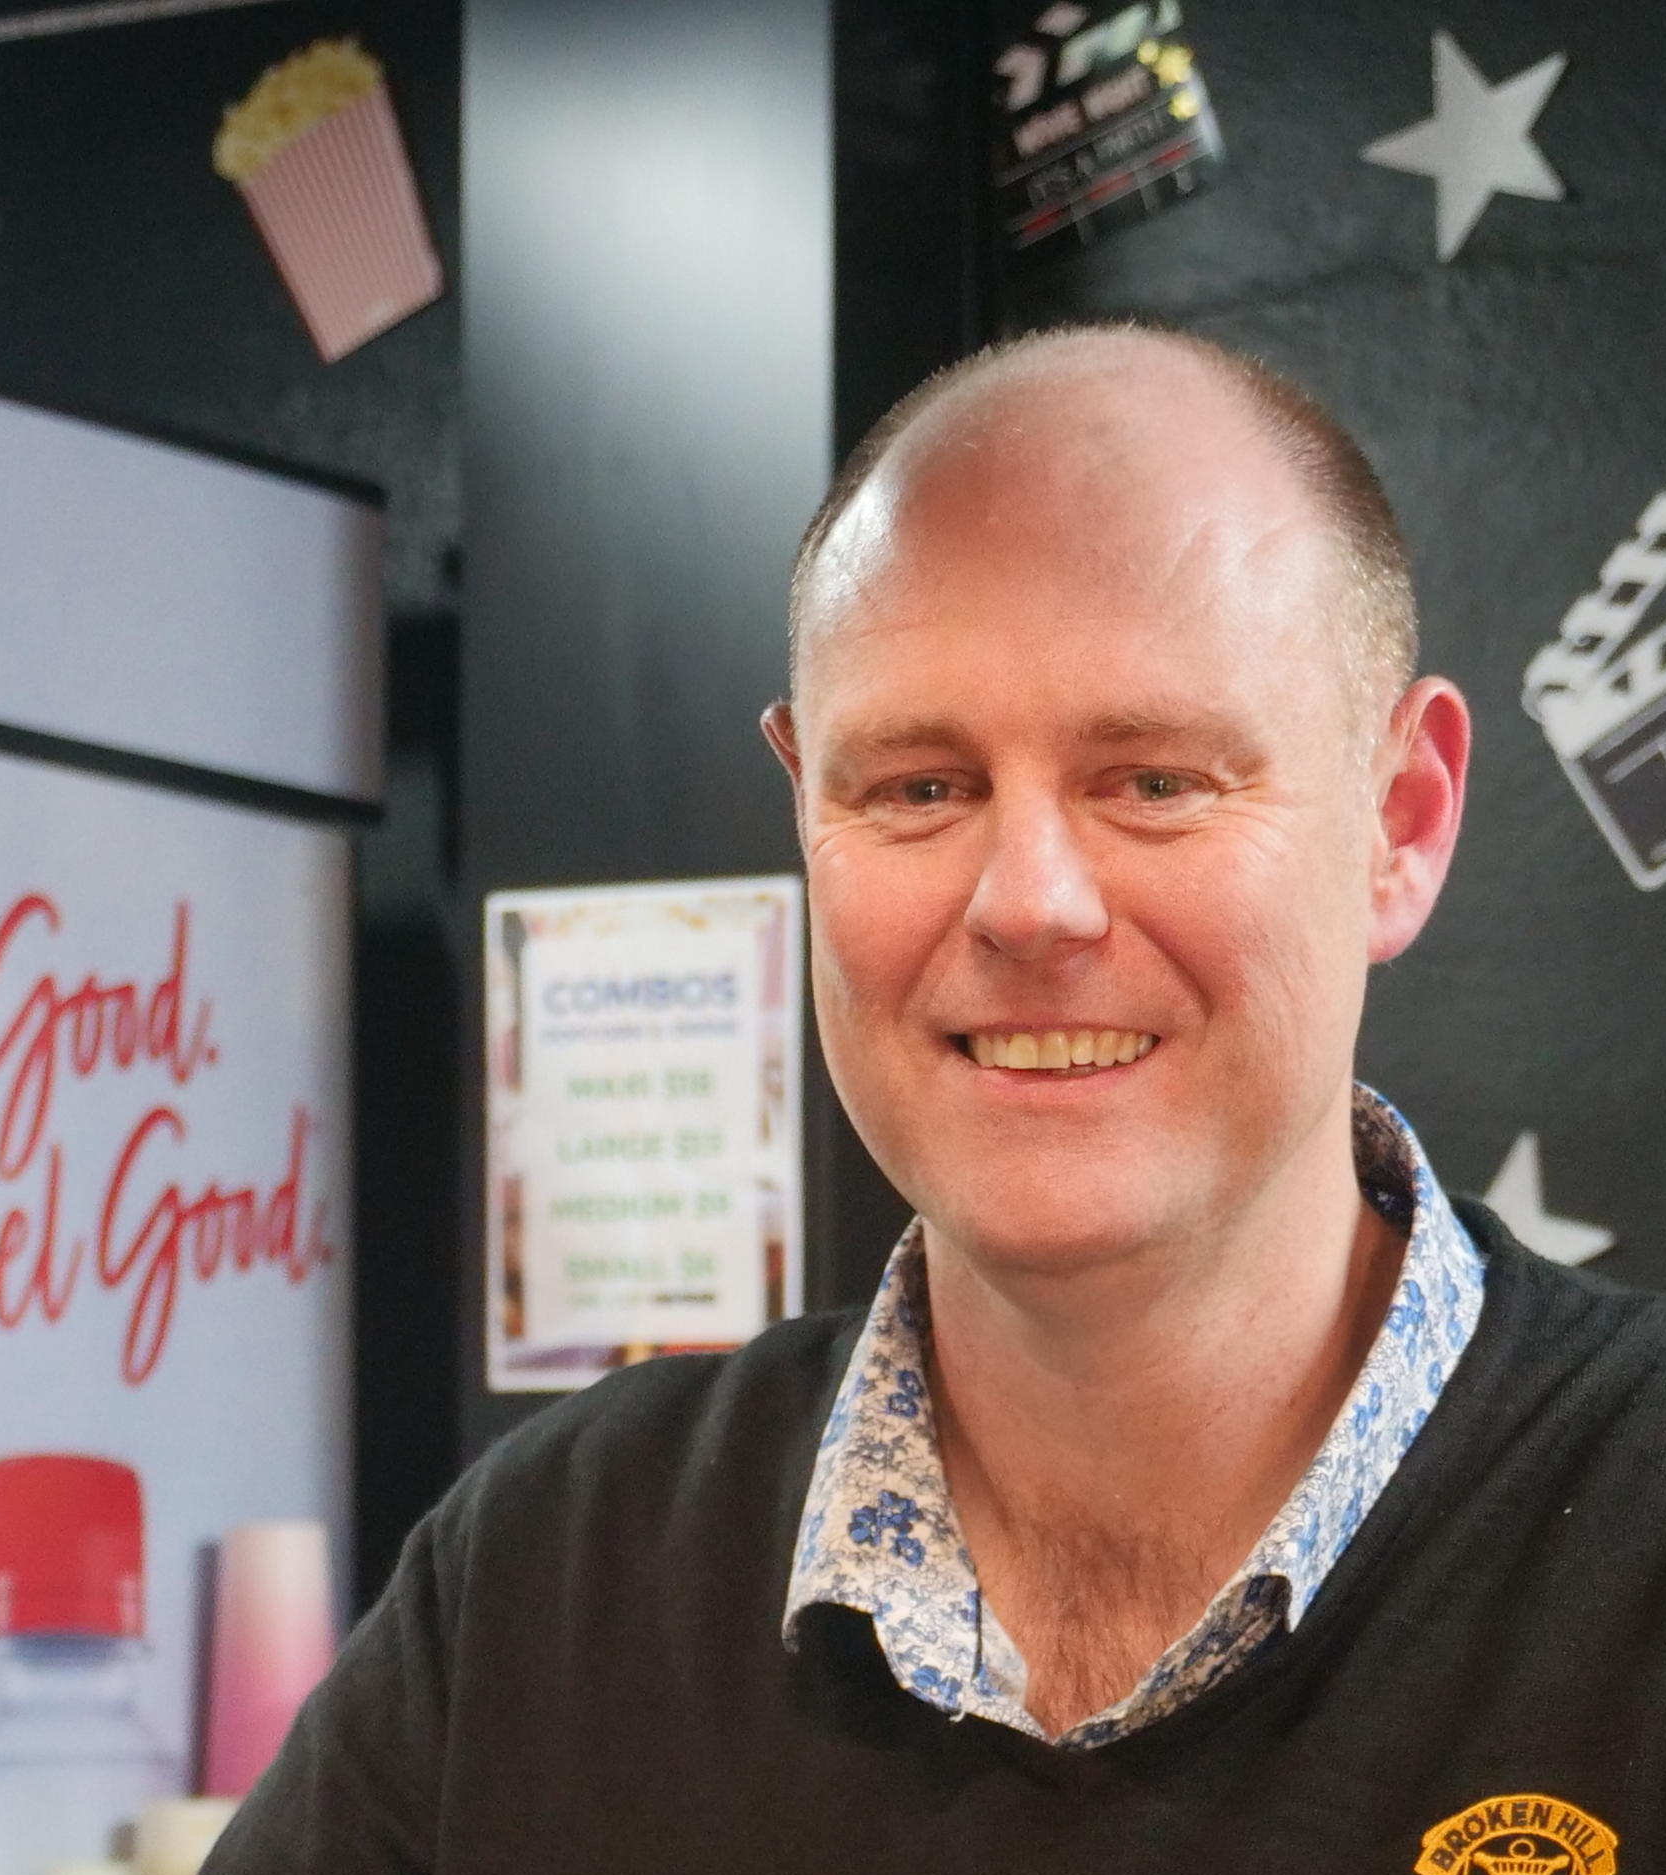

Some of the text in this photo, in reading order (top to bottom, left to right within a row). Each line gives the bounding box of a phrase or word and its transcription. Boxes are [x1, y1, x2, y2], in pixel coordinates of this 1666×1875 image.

[540, 970, 740, 1016] COMBOS
[1430, 1802, 1606, 1875] BROKEN HILL
